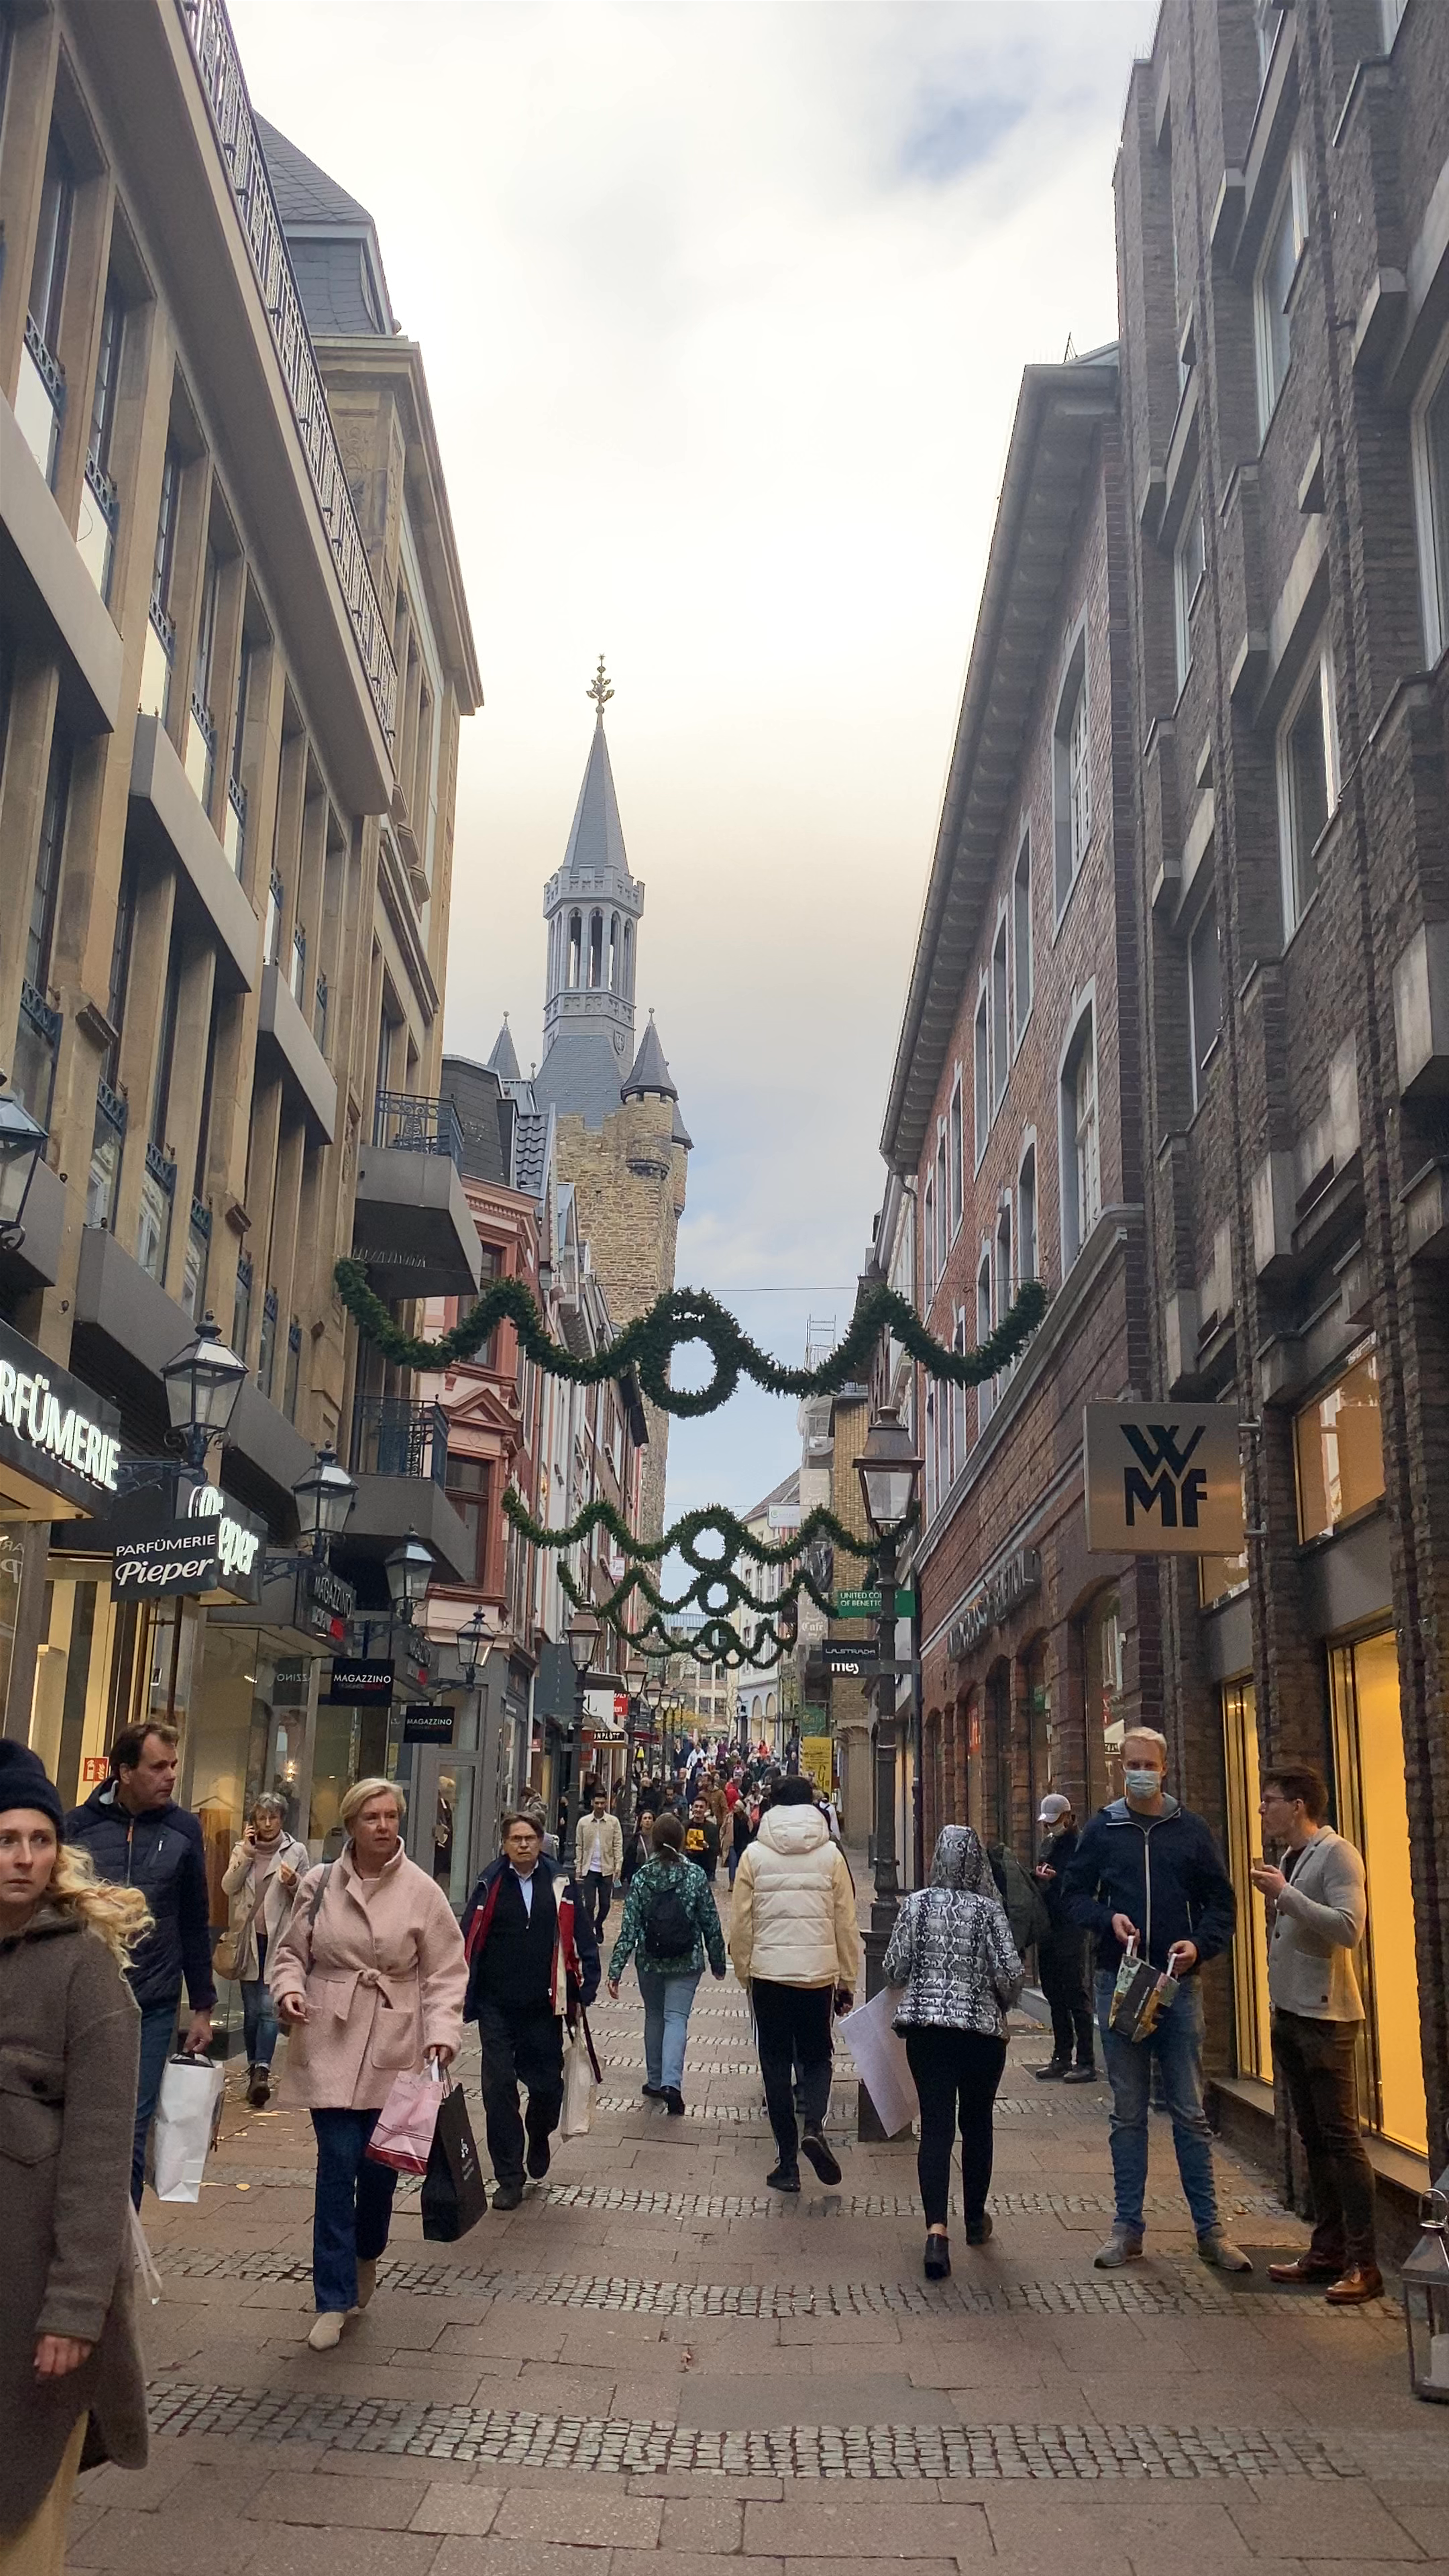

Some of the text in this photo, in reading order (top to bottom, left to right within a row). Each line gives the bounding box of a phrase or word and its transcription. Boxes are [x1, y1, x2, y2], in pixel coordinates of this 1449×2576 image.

[115, 1534, 216, 1557] PARFÜMERIE
[115, 1559, 214, 1586] Pieper
[334, 1674, 392, 1684] MAGAZZINO
